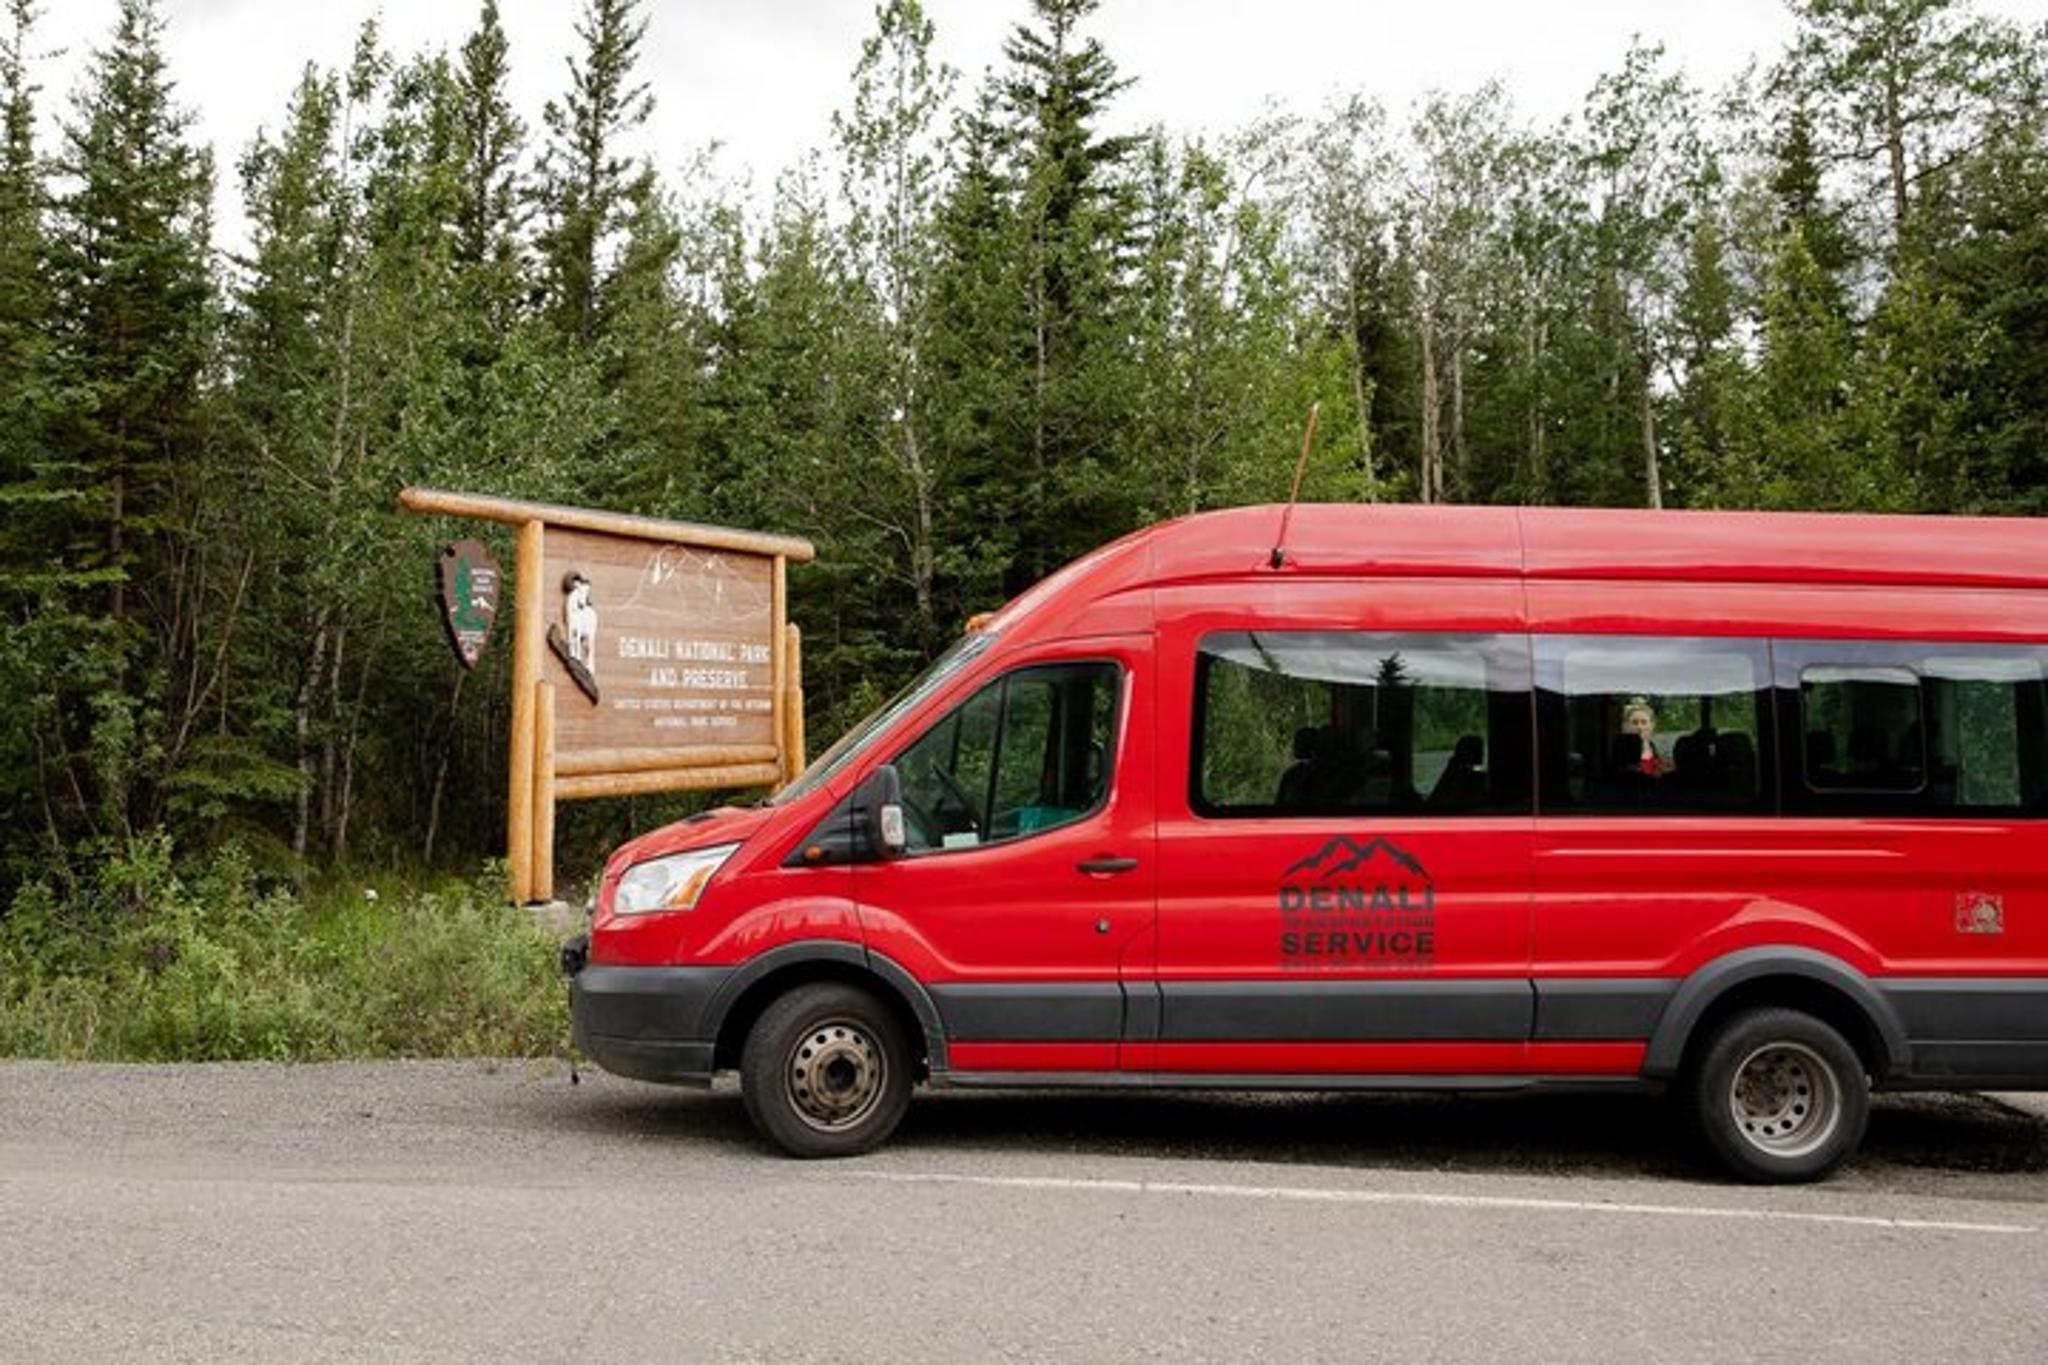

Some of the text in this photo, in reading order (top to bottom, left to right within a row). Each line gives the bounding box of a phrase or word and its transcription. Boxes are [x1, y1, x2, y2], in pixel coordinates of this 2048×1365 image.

[619, 636, 770, 664] DENALI NATIONAL PARK
[650, 667, 748, 689] AND PRESERVE
[1279, 884, 1434, 911] DENALI
[1281, 932, 1434, 955] SERVICE
